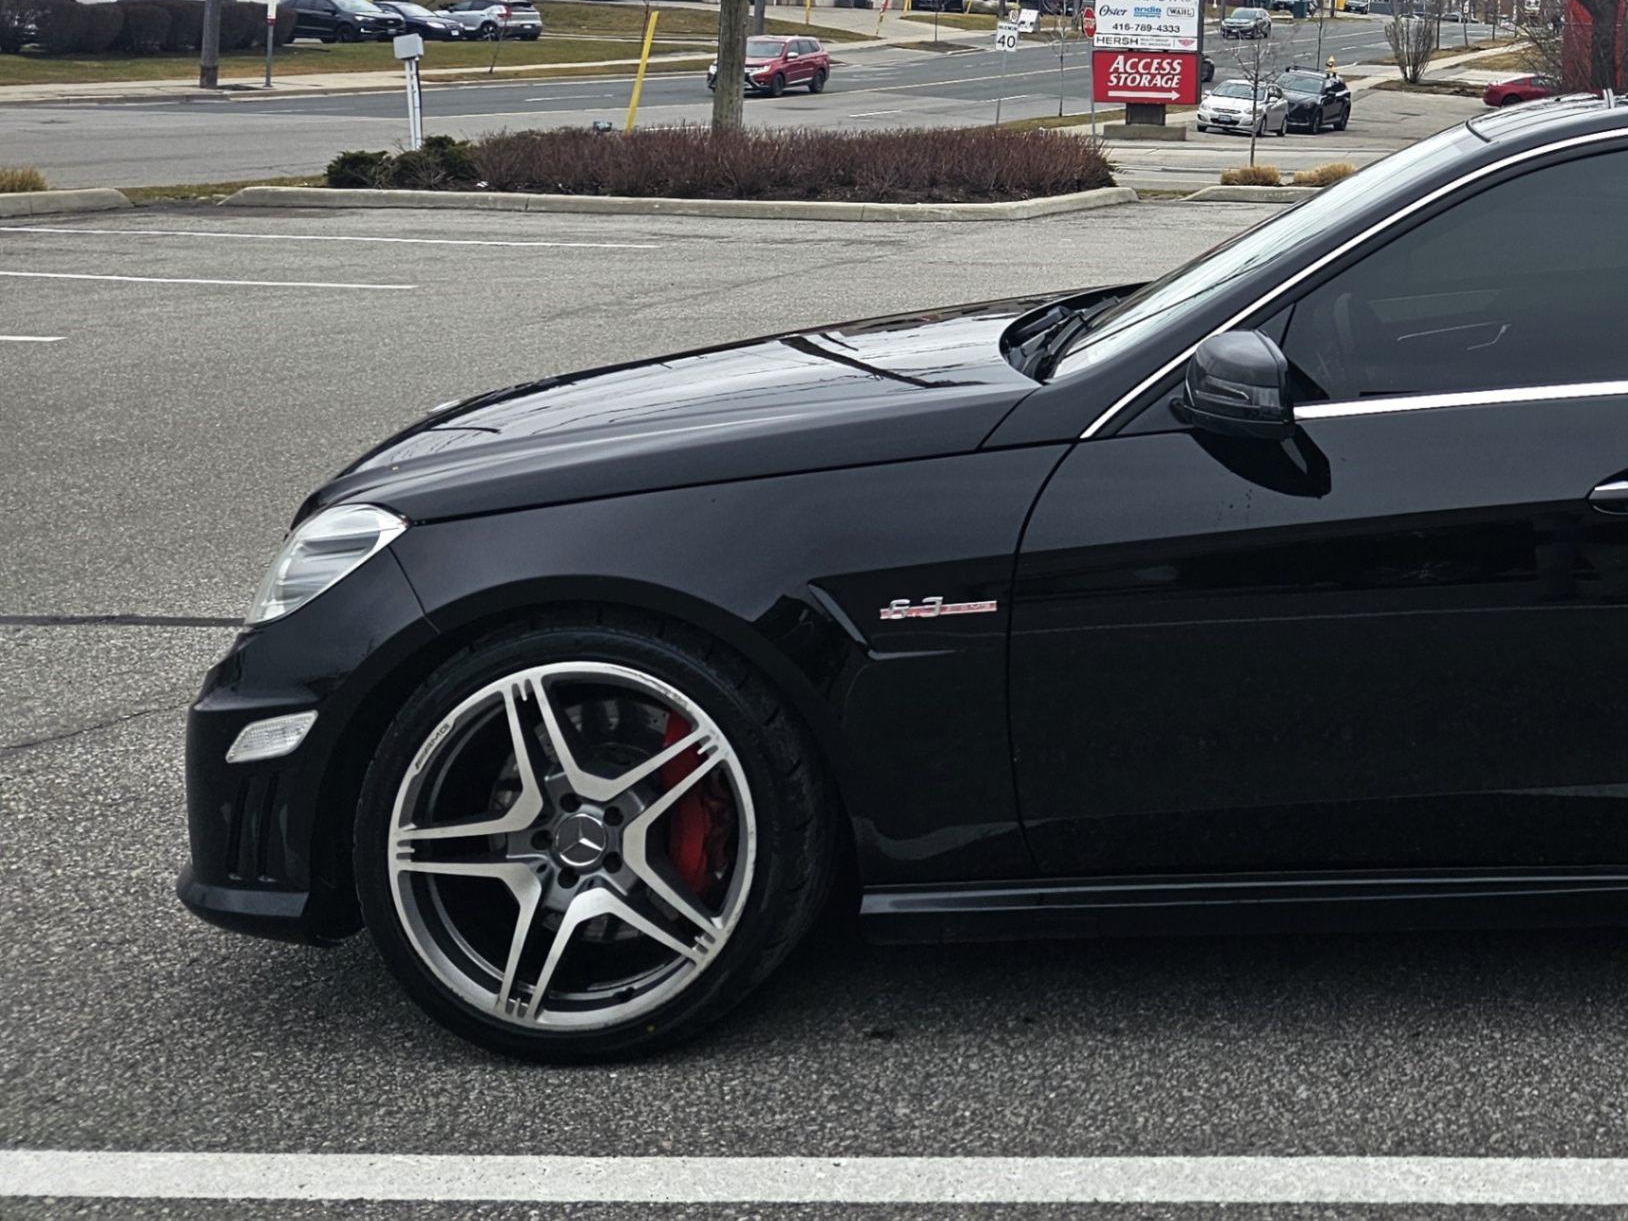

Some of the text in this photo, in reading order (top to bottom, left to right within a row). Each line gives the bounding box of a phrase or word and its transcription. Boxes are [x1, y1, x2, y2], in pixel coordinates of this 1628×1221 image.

[1099, 4, 1128, 17] Oster
[1170, 8, 1191, 16] WAHL
[1112, 23, 1180, 33] 416-789-4333
[997, 34, 1016, 49] 40
[1096, 36, 1139, 46] HERSH
[1109, 54, 1182, 74] ACCESS
[1107, 73, 1182, 88] STORAGE
